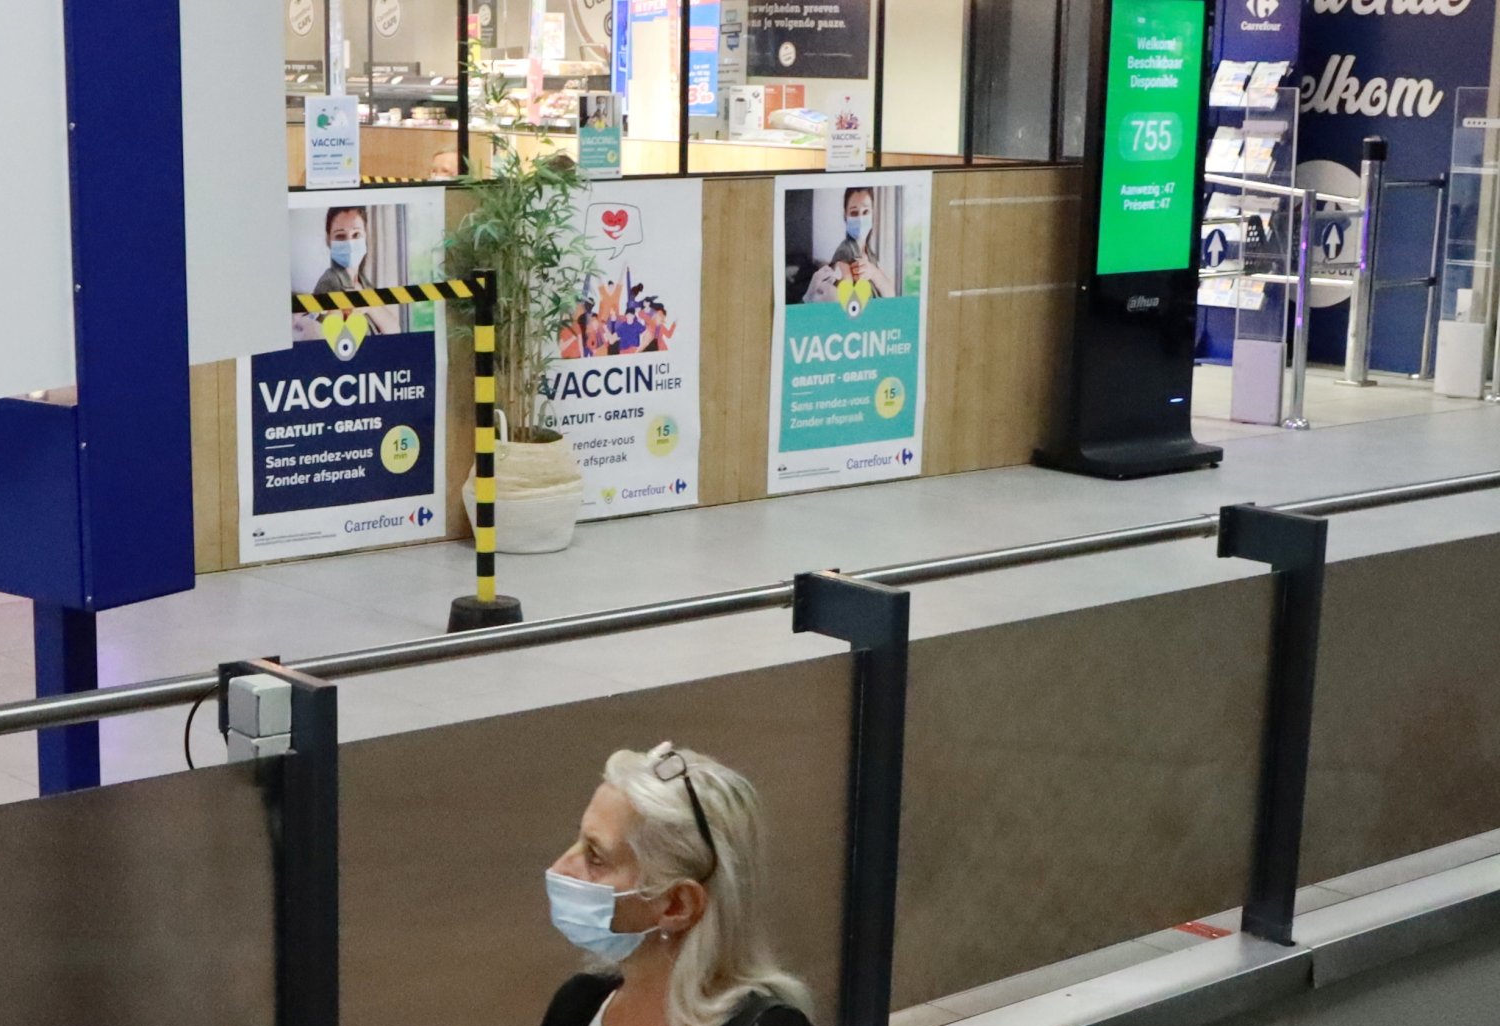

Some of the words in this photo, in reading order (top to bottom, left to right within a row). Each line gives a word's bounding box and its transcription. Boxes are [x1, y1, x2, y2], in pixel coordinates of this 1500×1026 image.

[1241, 21, 1282, 32] Carrefour
[1130, 74, 1179, 91] Disponible
[1300, 54, 1444, 118] elkom
[311, 137, 346, 148] VACCIN
[1130, 119, 1172, 152] 755
[789, 329, 887, 364] VACCIN
[886, 342, 912, 355] HIER
[541, 364, 653, 401] VACCIN
[655, 363, 670, 375] ICI
[655, 377, 682, 391] HIER
[791, 373, 836, 387] GRATUIT
[842, 369, 878, 382] GRATIS
[258, 371, 393, 413] VACCIN
[393, 369, 411, 384] ICI
[393, 385, 425, 401] HIER
[884, 388, 896, 399] 15
[604, 407, 645, 421] GRATIS
[790, 401, 814, 412] Sans
[265, 422, 324, 440] GRATUIT
[334, 417, 382, 433] GRATIS
[656, 425, 670, 437] 15
[393, 438, 408, 452] 15
[572, 435, 635, 451] rendez-vous
[265, 456, 296, 469] Sans
[299, 448, 374, 465] rendez-vous
[583, 452, 628, 467] afspraak
[846, 454, 893, 470] Carrefour
[265, 475, 311, 488] Zonder
[313, 465, 366, 484] afspraak
[621, 484, 666, 499] Carrefour
[344, 515, 404, 533] Carrefour
